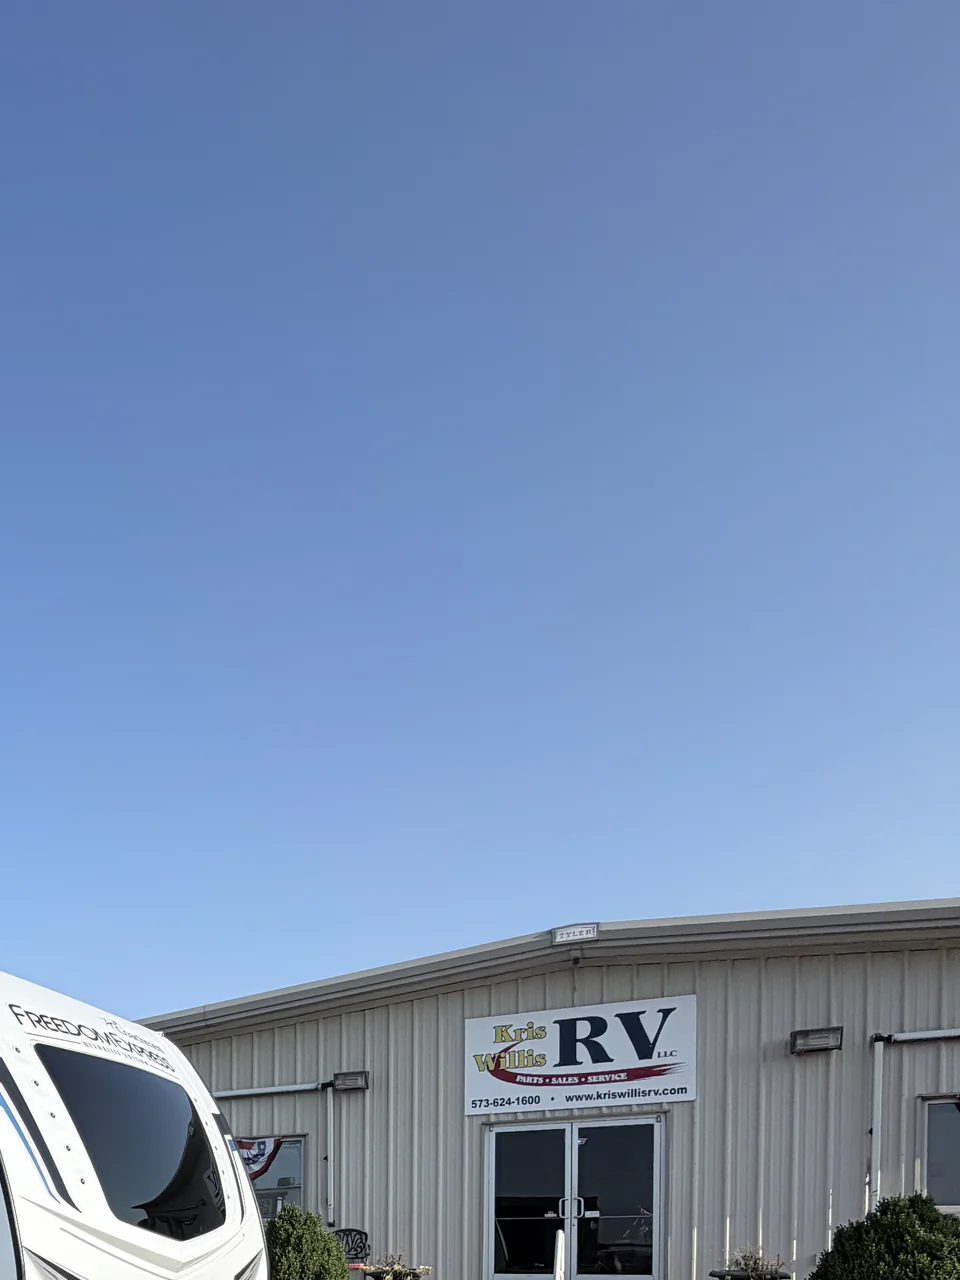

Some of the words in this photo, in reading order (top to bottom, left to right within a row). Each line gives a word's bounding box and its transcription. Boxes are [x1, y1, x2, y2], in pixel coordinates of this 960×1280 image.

[493, 1021, 547, 1044] Kris
[552, 1007, 677, 1068] RV
[473, 1049, 547, 1072] Willis
[657, 1050, 678, 1059] LLC
[515, 1075, 544, 1084] PARTS
[551, 1076, 579, 1084] SALES
[587, 1072, 628, 1083] SERVICE
[471, 1095, 541, 1109] 573-624-1600
[565, 1086, 688, 1103] www.kriswillisrv.com
